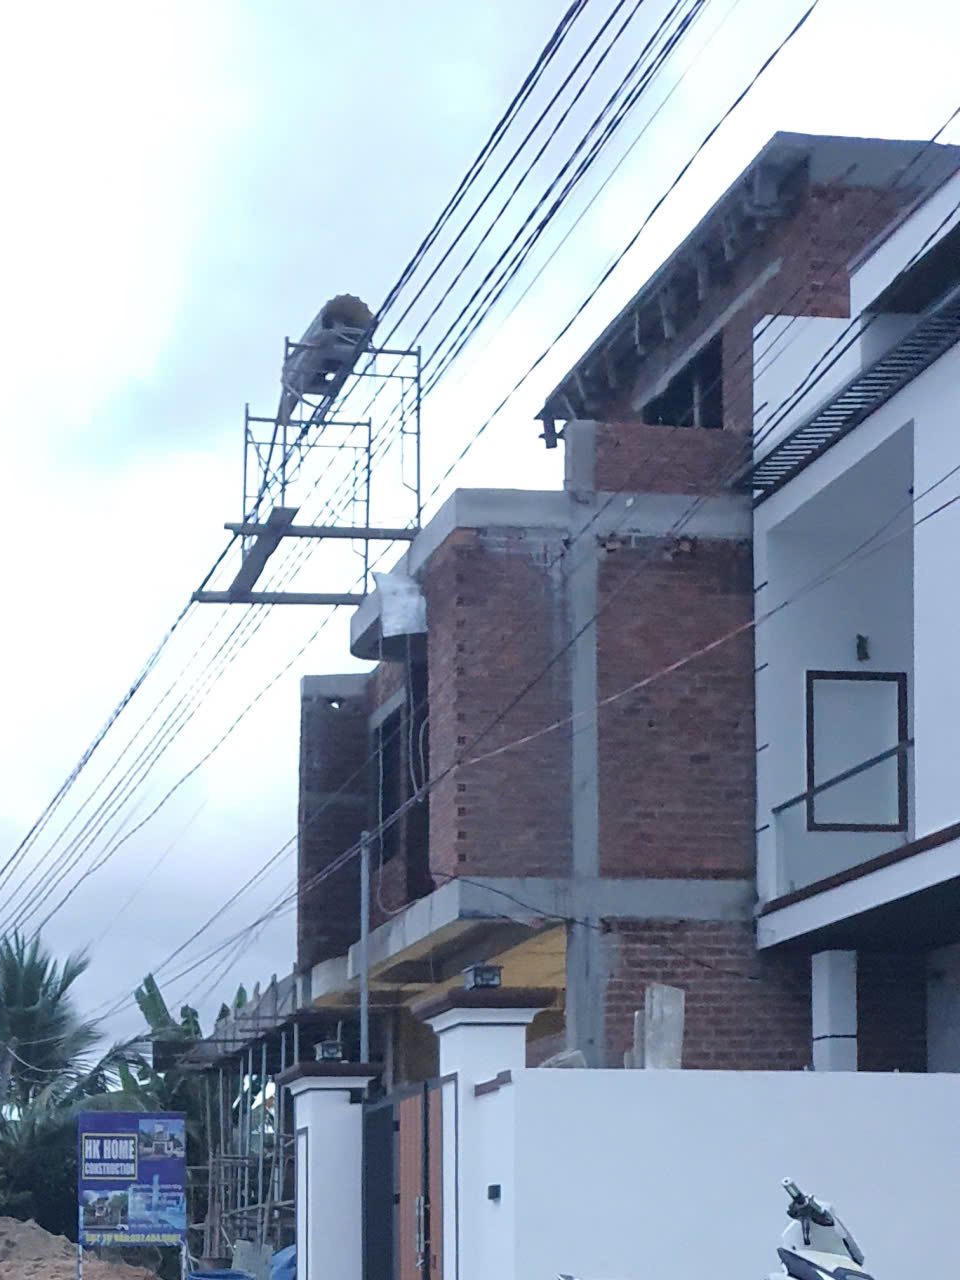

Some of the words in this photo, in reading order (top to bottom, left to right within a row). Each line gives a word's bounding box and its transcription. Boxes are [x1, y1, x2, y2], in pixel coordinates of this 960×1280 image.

[84, 1139, 100, 1159] HK
[103, 1139, 135, 1159] HOME
[84, 1162, 135, 1175] CONSTRUCTION
